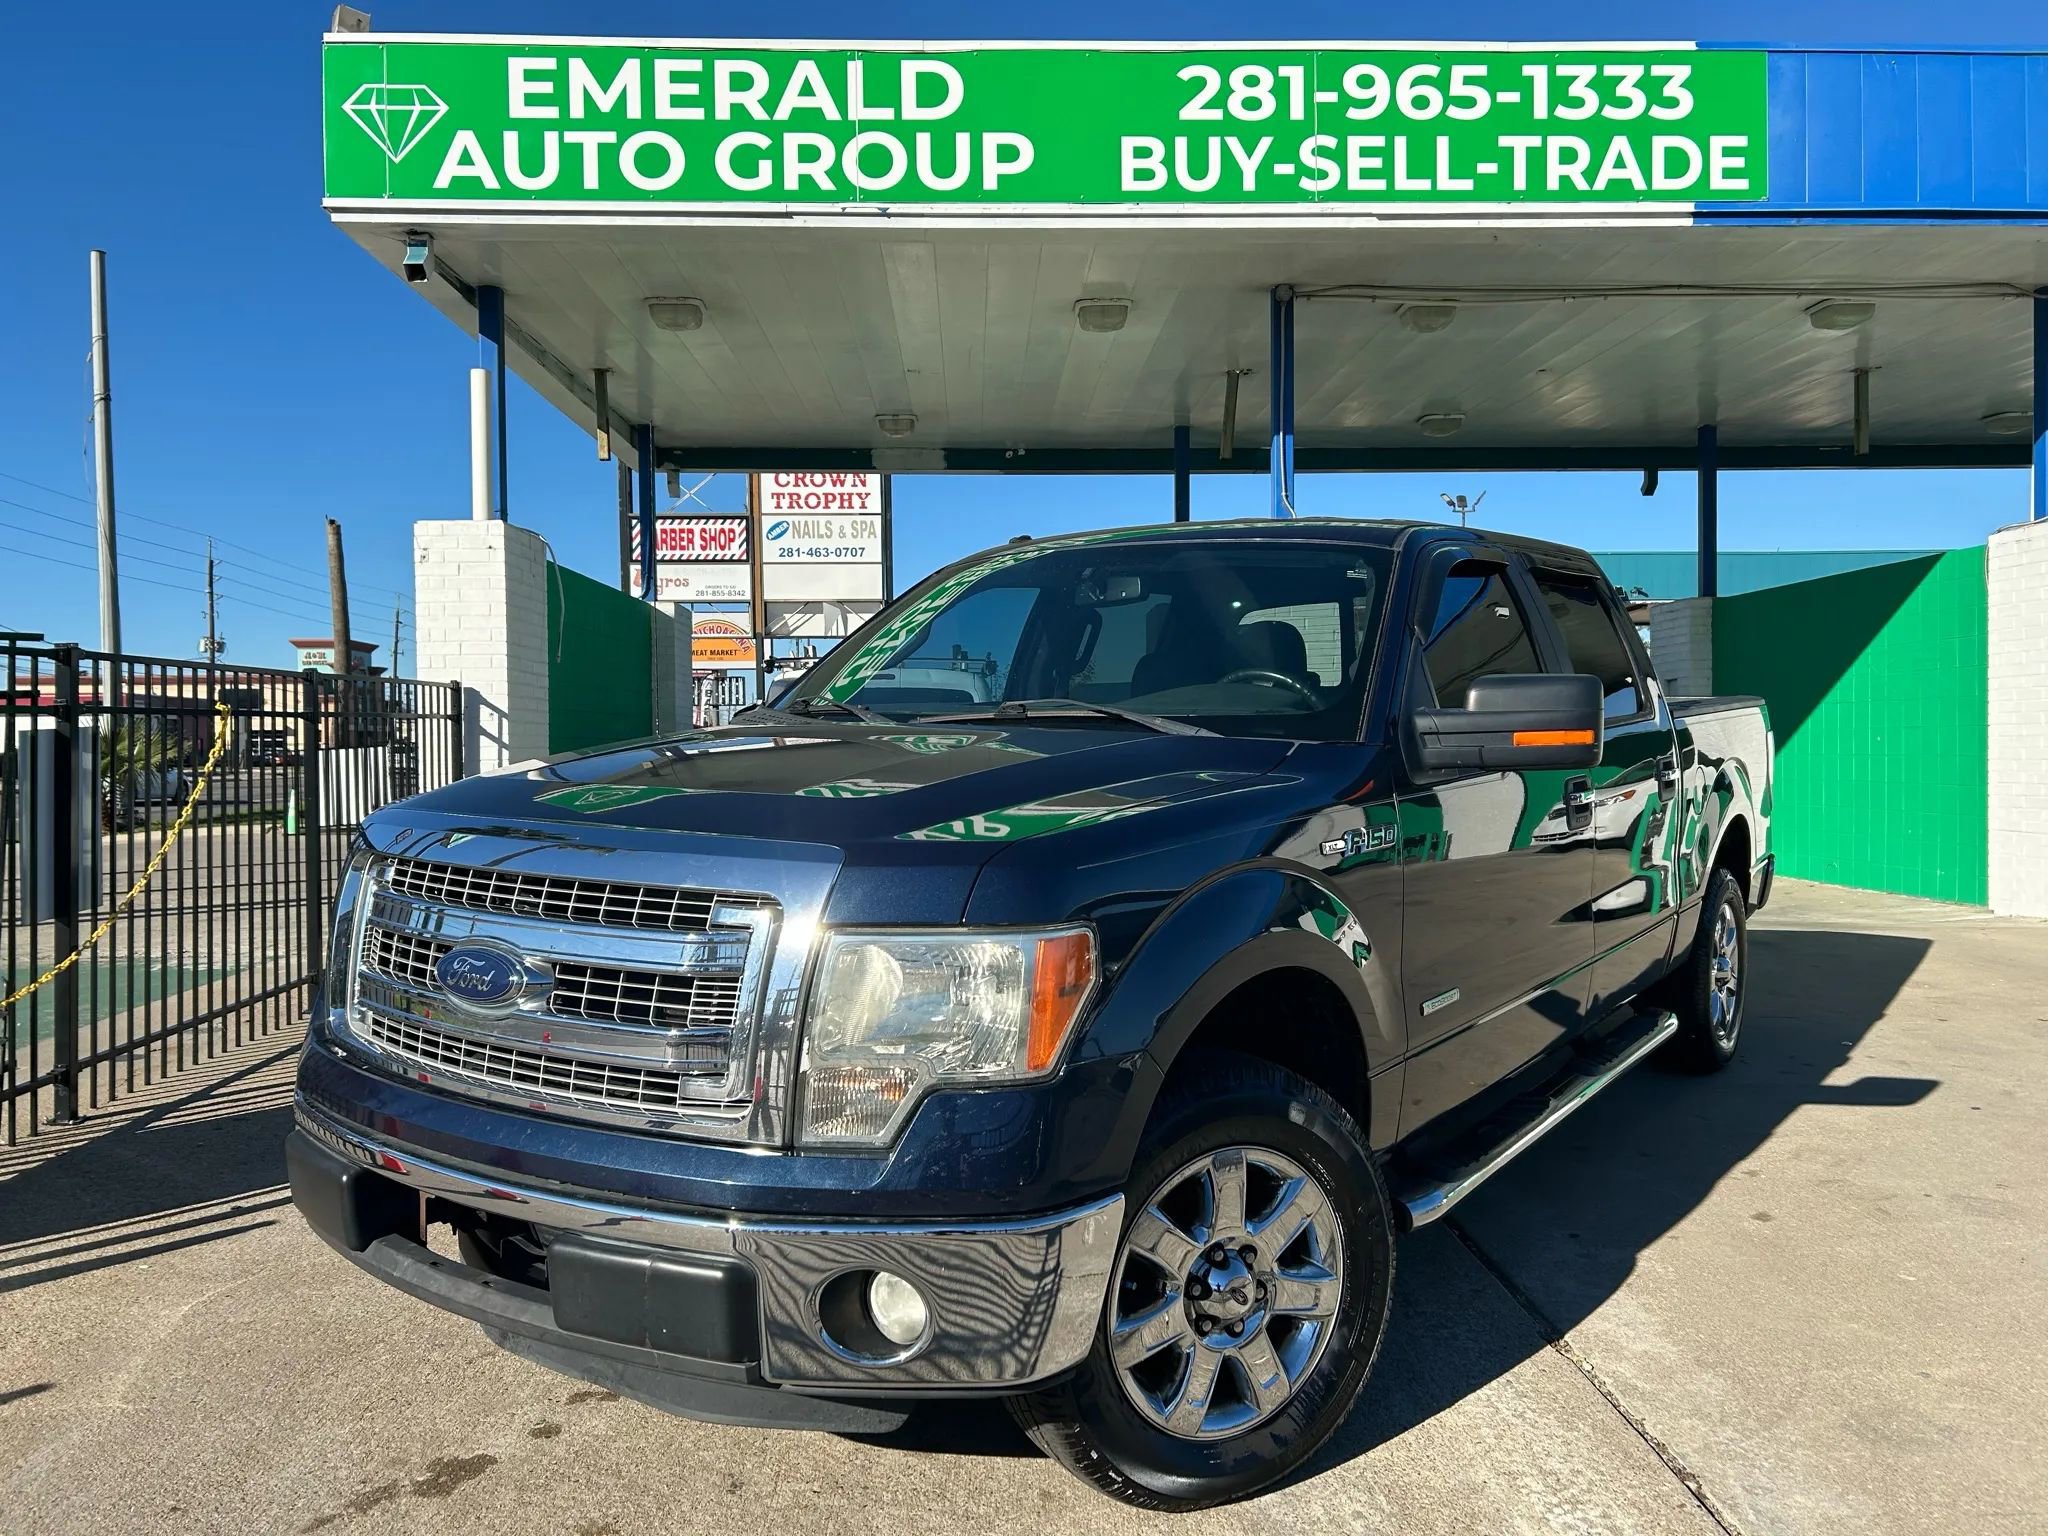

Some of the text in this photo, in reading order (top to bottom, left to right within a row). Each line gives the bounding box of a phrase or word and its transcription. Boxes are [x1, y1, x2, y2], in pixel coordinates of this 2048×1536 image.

[507, 57, 965, 122] EMERALD
[1176, 63, 1695, 122] 281-965-1333
[432, 129, 1035, 192] AUTO GROUP
[1119, 135, 1751, 192] BUY-SELL-TRADE
[774, 472, 868, 488] CROWN
[771, 492, 871, 510] TROPHY
[700, 528, 736, 551] SHOP
[767, 521, 790, 540] AMBER
[791, 520, 877, 539] NAILS & SPA
[778, 547, 866, 558] 281-463-0707
[695, 589, 746, 597] 281-855-8342
[447, 956, 496, 992] Ford
